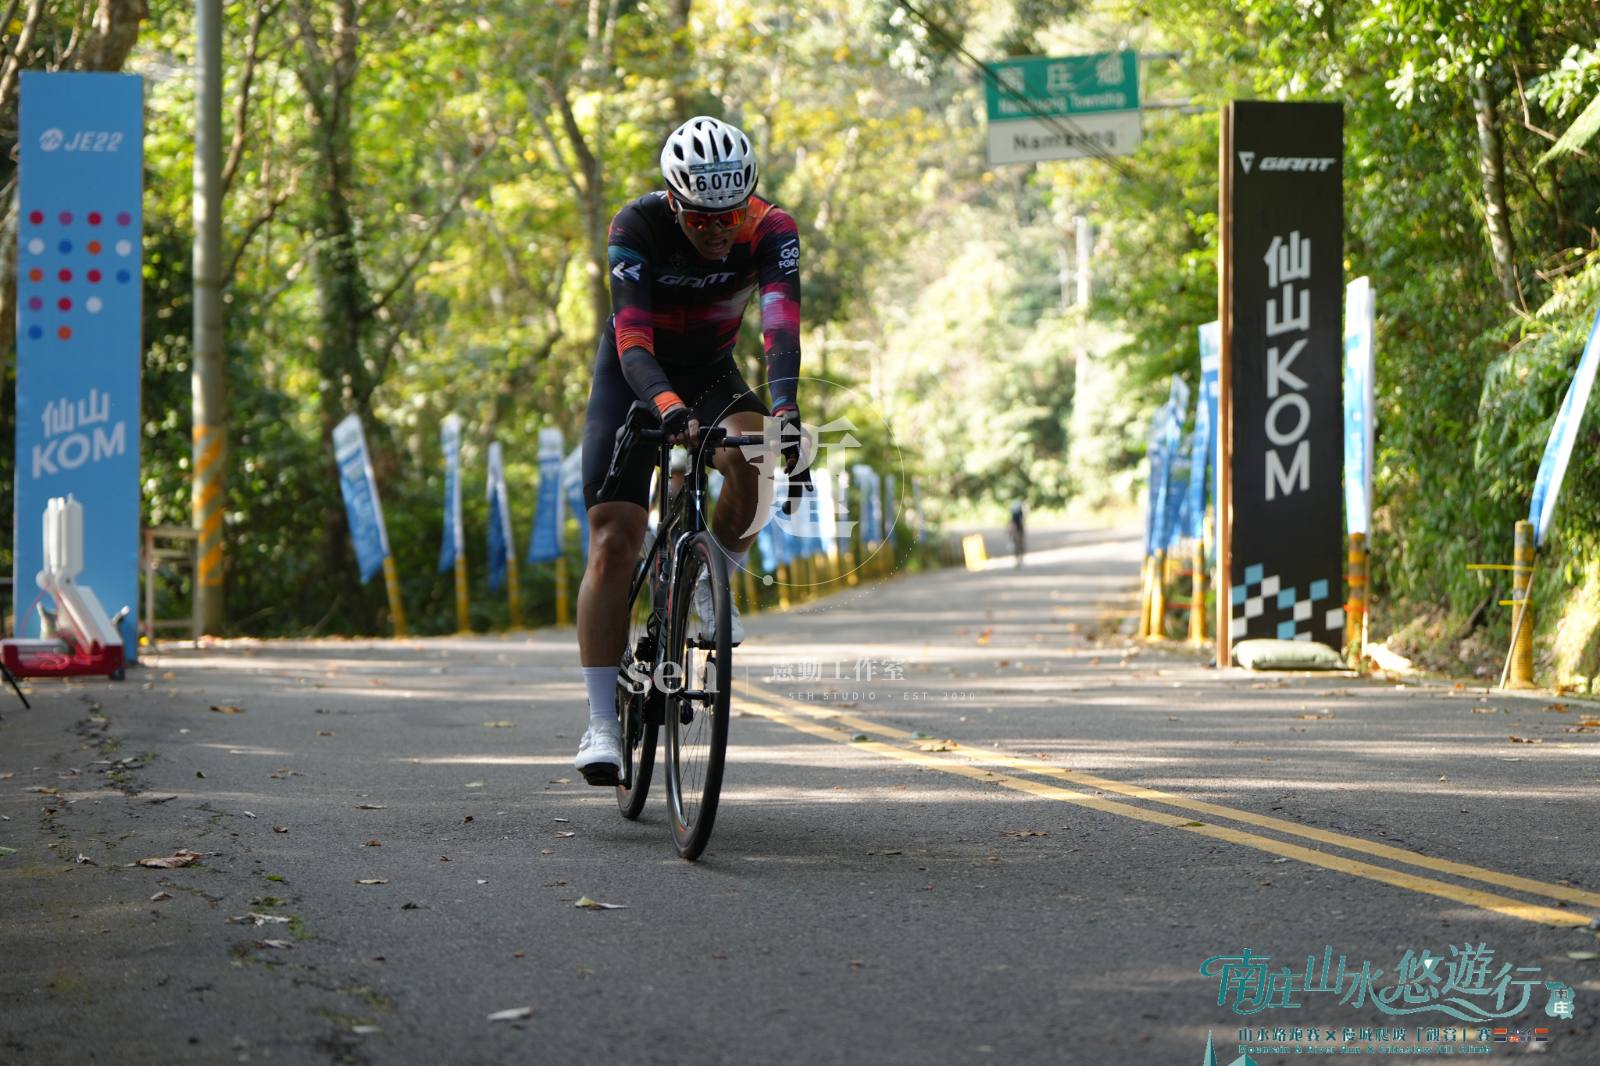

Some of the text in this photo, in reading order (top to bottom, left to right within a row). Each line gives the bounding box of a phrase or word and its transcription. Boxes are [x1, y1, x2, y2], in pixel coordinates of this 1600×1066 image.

[64, 131, 124, 152] JE22
[1259, 156, 1336, 173] GIANT
[781, 247, 799, 258] GO
[657, 272, 737, 289] GIANT
[41, 388, 110, 438] 仙山
[31, 420, 125, 480] KOM
